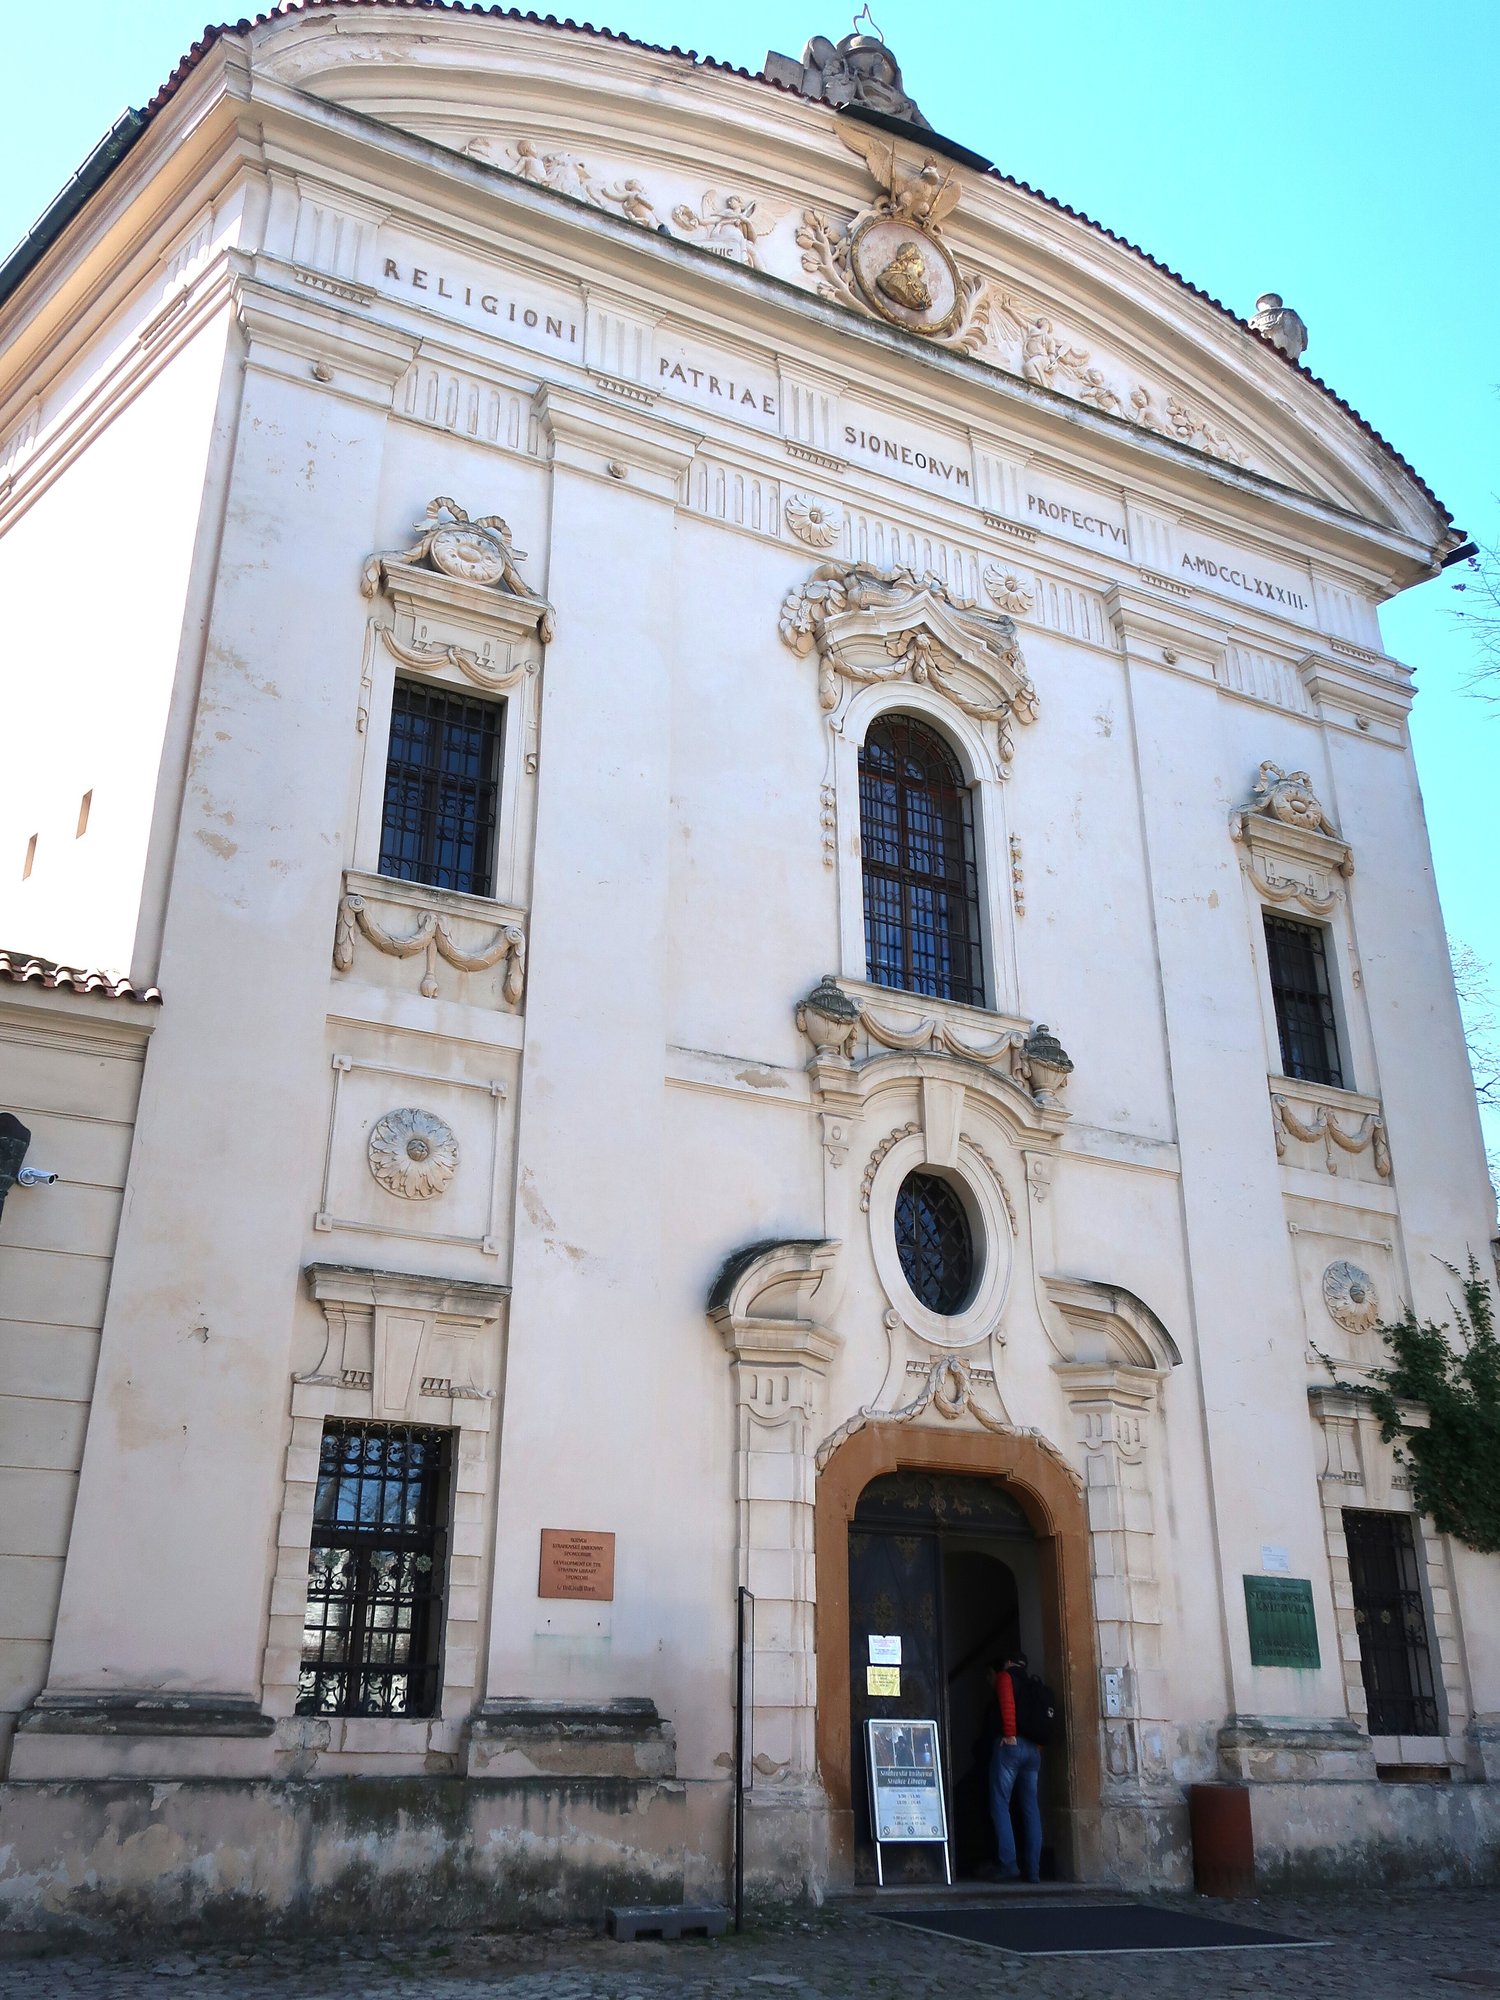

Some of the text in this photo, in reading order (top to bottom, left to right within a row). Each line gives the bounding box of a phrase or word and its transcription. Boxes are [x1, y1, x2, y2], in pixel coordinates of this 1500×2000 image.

[383, 257, 577, 344] RELIGIONI
[659, 357, 776, 416] PATRIAE
[844, 425, 970, 487] SIONEORVM
[1027, 493, 1127, 546] PROFECTVI
